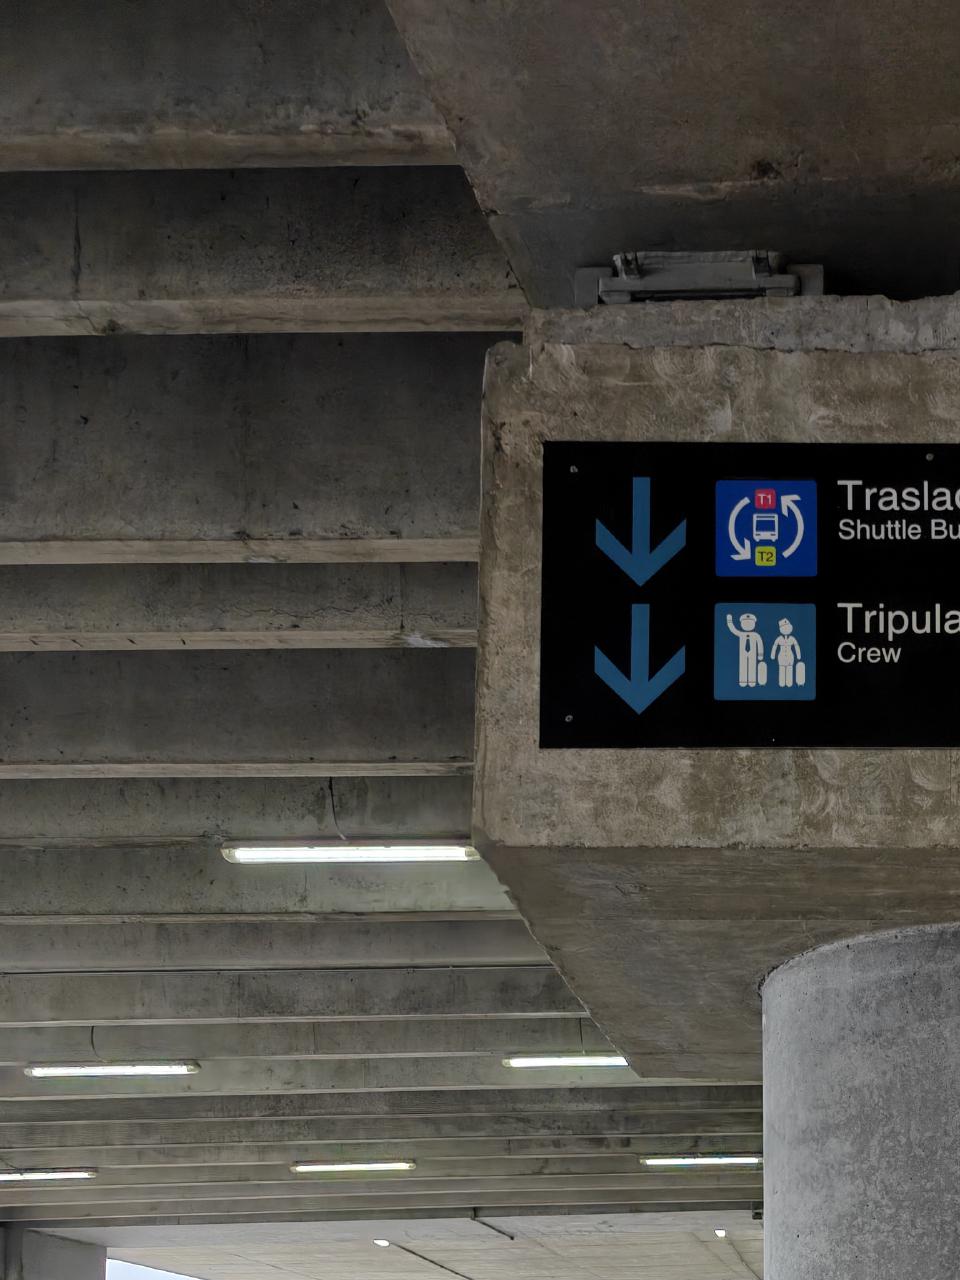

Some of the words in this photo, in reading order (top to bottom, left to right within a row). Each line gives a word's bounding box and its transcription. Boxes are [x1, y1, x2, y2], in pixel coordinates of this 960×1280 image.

[757, 493, 773, 505] T1
[838, 518, 922, 540] Shuttle
[758, 550, 774, 562] T2
[837, 641, 902, 663] Crew
